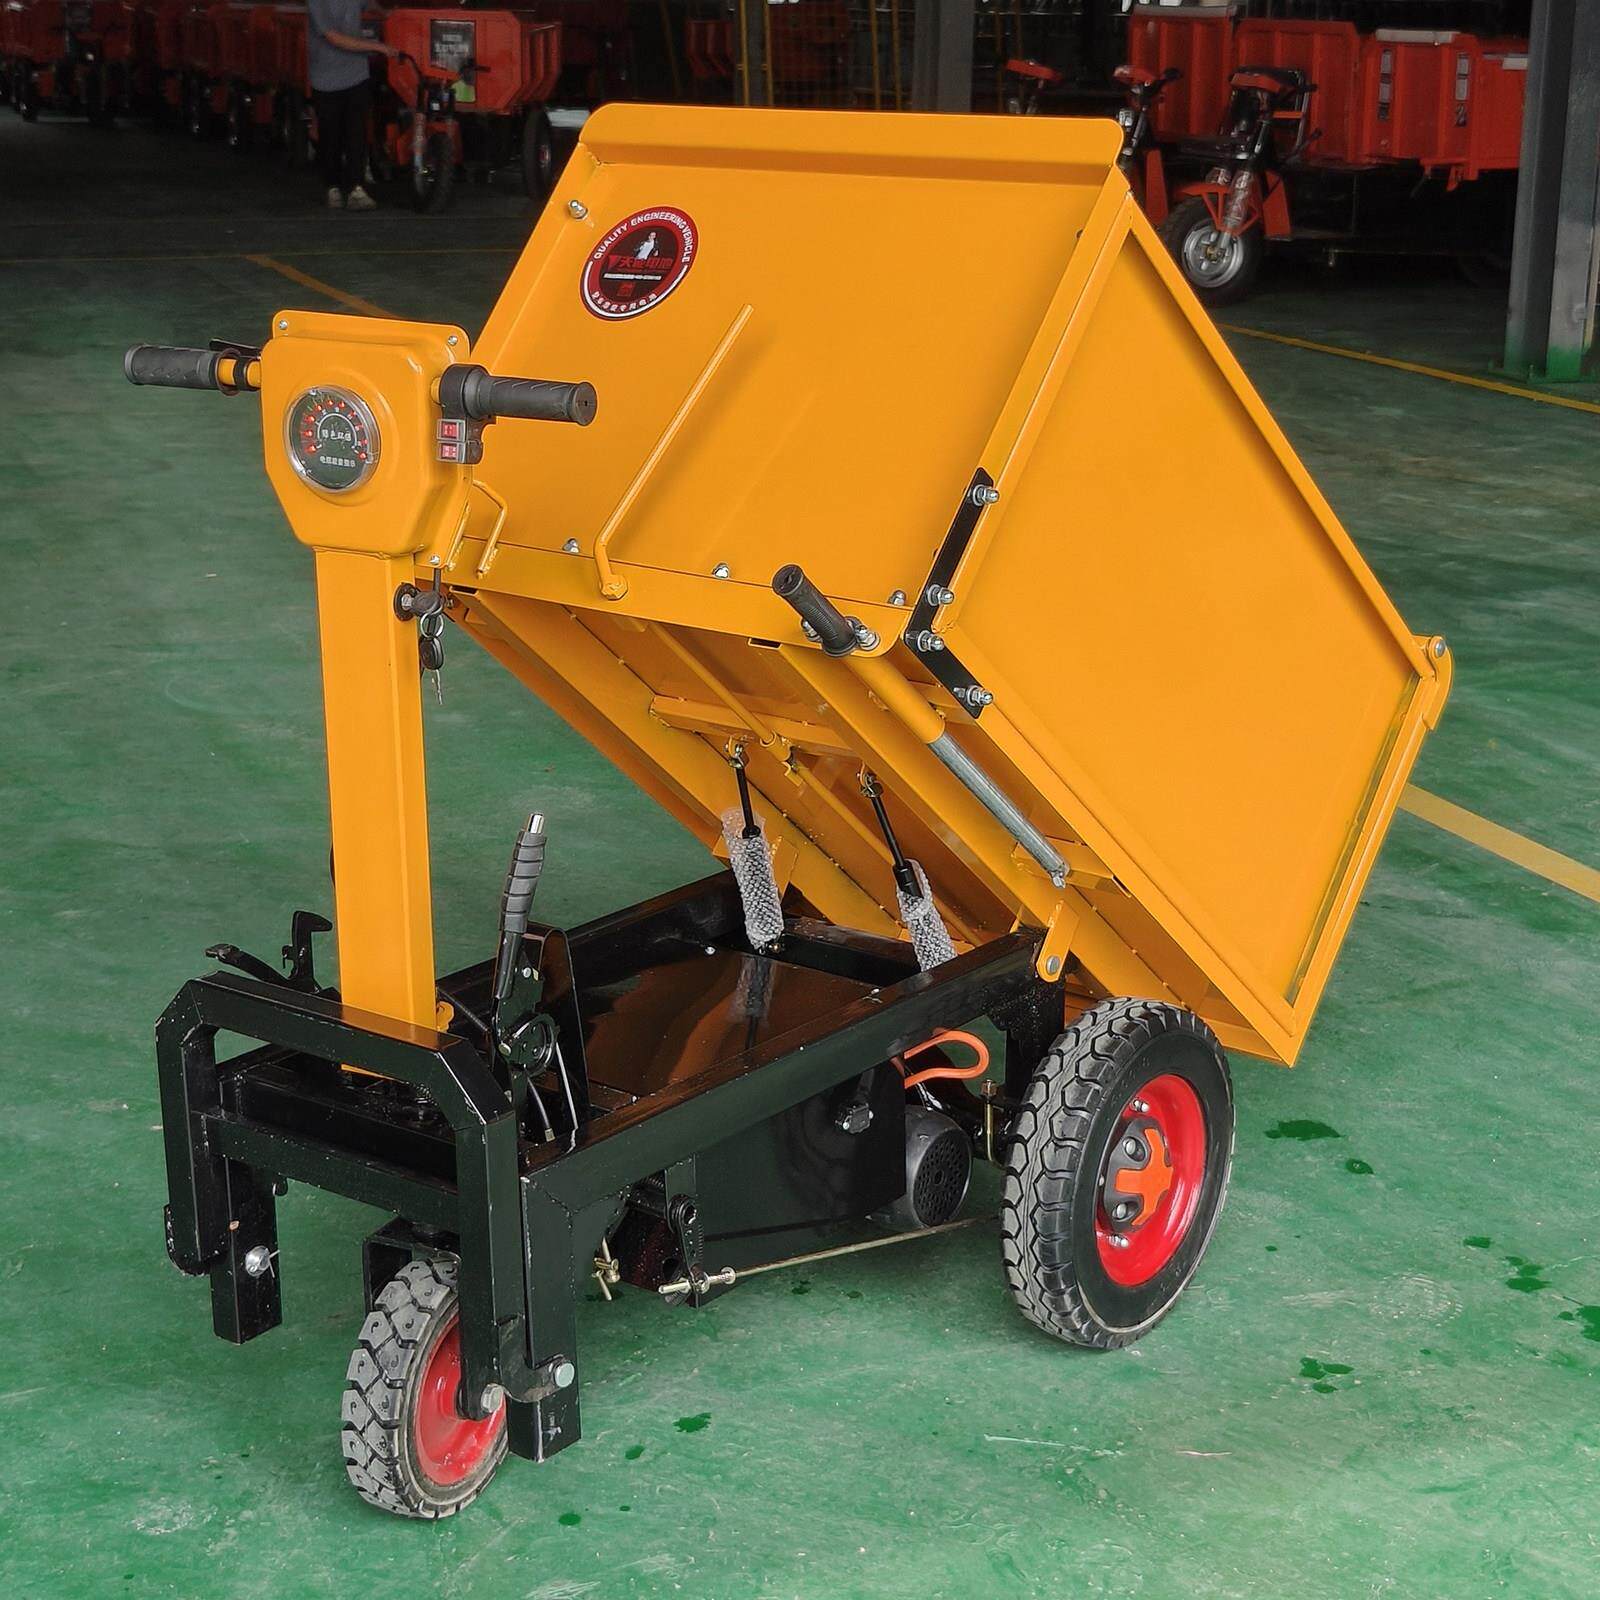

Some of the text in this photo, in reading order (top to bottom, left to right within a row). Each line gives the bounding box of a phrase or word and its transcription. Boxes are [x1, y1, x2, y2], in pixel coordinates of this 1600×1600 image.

[593, 211, 693, 263] QUALITY ENGINEERING VEHICLE
